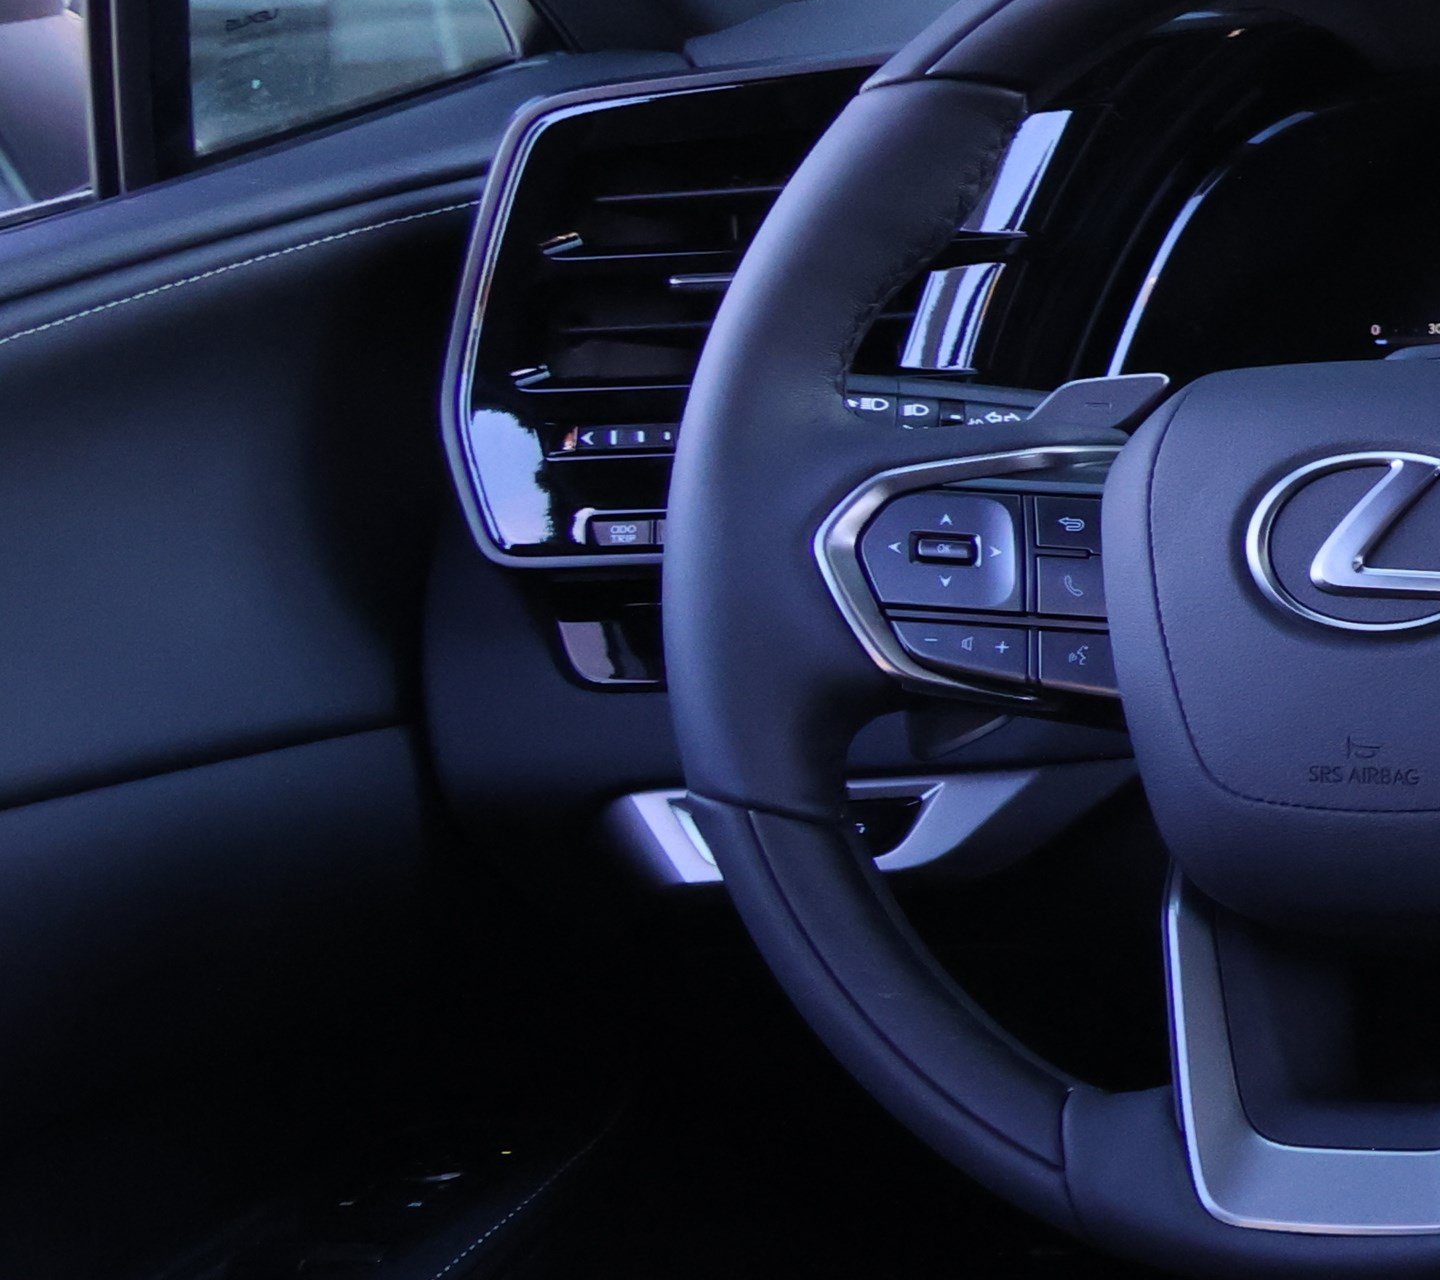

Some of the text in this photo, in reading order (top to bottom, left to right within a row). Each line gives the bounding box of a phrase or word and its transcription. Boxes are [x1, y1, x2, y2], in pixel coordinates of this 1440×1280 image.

[1369, 323, 1382, 336] 0
[1309, 765, 1420, 785] SRS AIRBAG
